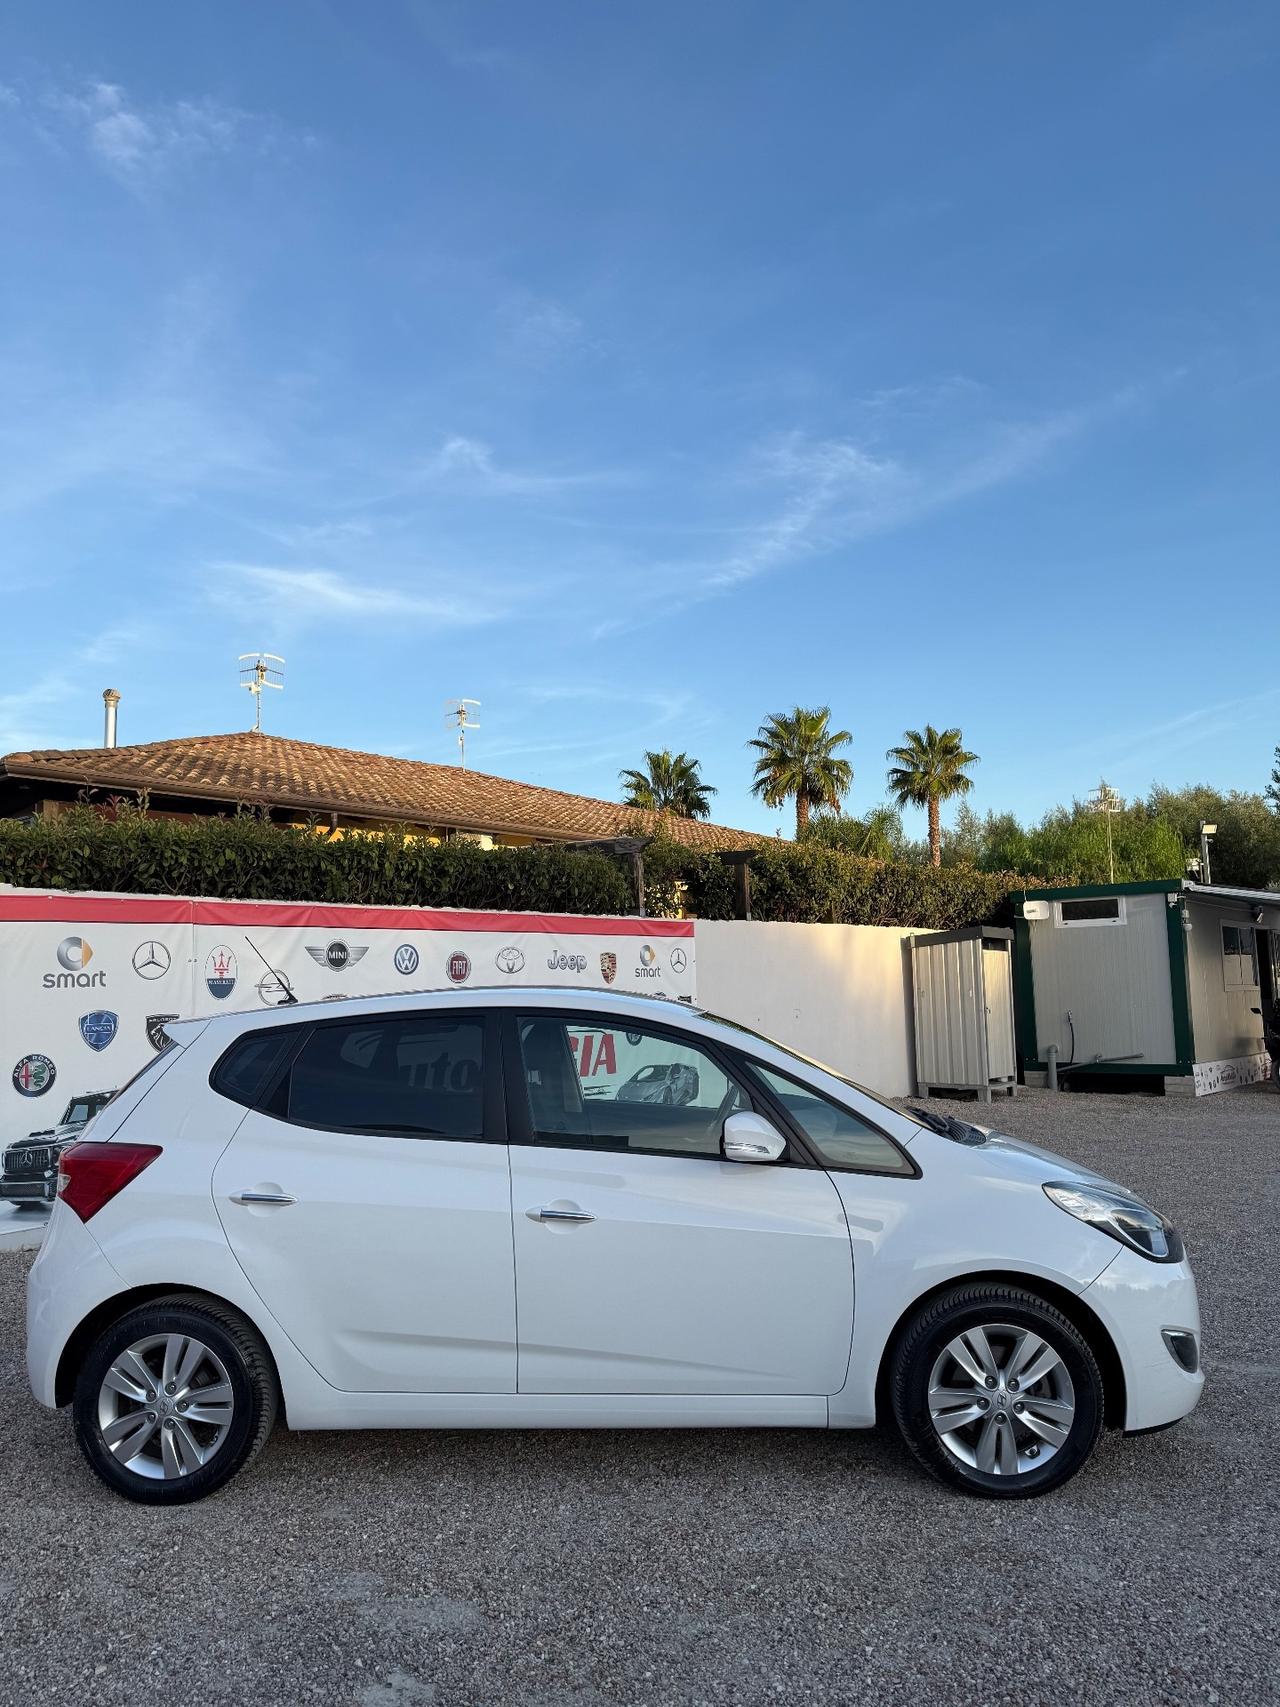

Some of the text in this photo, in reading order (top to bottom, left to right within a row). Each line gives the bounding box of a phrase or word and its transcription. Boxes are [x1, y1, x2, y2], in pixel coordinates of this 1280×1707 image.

[328, 950, 348, 960] MINI
[547, 950, 588, 974] Jeep
[452, 960, 467, 975] FIAT
[634, 966, 661, 978] smart
[42, 970, 107, 989] smart
[13, 1055, 55, 1078] ALFA ROMEO
